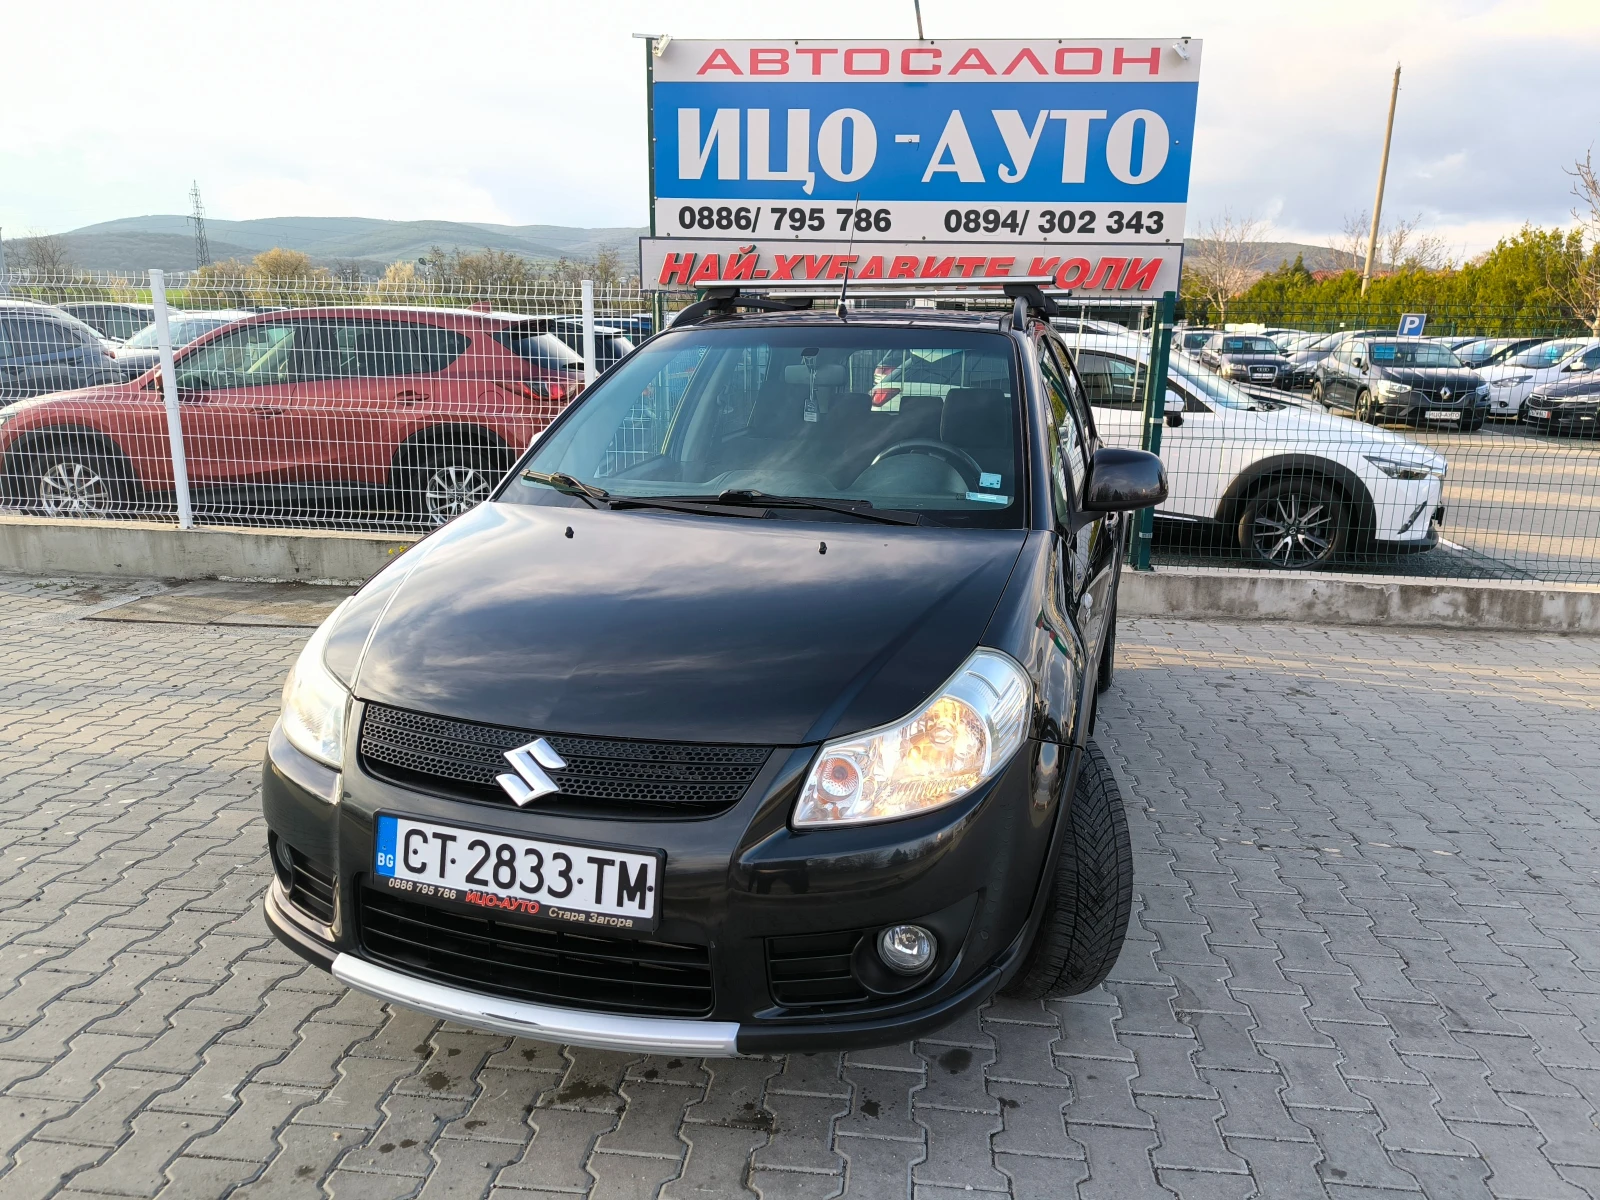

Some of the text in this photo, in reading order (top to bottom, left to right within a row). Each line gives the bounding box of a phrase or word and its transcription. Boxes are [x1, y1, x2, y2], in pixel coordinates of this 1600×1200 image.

[696, 47, 1161, 76] АВТОСАЛОН
[678, 205, 892, 233] 0886/ 795 786
[943, 208, 1165, 236] 0894/ 302 343
[657, 245, 1164, 291] НАЙ-ХУБАВИТЕ КОЛИ
[1402, 316, 1420, 335] P
[377, 852, 395, 868] BG
[465, 839, 574, 899] 2833
[388, 878, 457, 900] 0886 795 786
[465, 890, 540, 914] ИЦО-АУТО
[548, 907, 634, 928] Стара Загора
